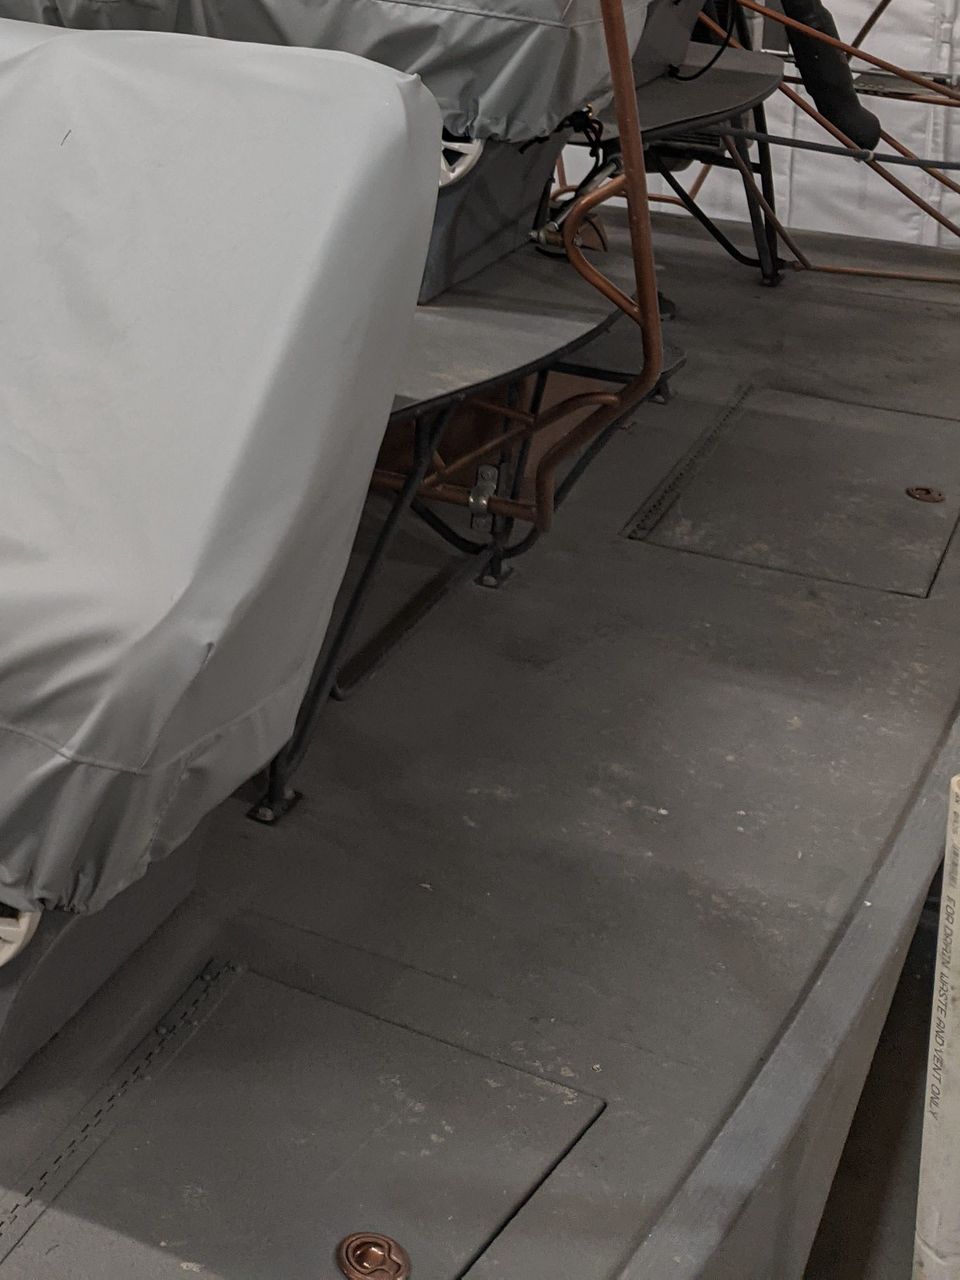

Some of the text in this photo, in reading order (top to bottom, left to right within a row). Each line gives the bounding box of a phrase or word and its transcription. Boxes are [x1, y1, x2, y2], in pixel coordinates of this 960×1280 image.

[944, 895, 957, 924] FOR
[939, 925, 954, 970] DRAIN
[936, 972, 949, 1017] WASTE
[933, 1018, 947, 1046] AND
[929, 1048, 945, 1082] VENT
[927, 1083, 942, 1121] ONLY
